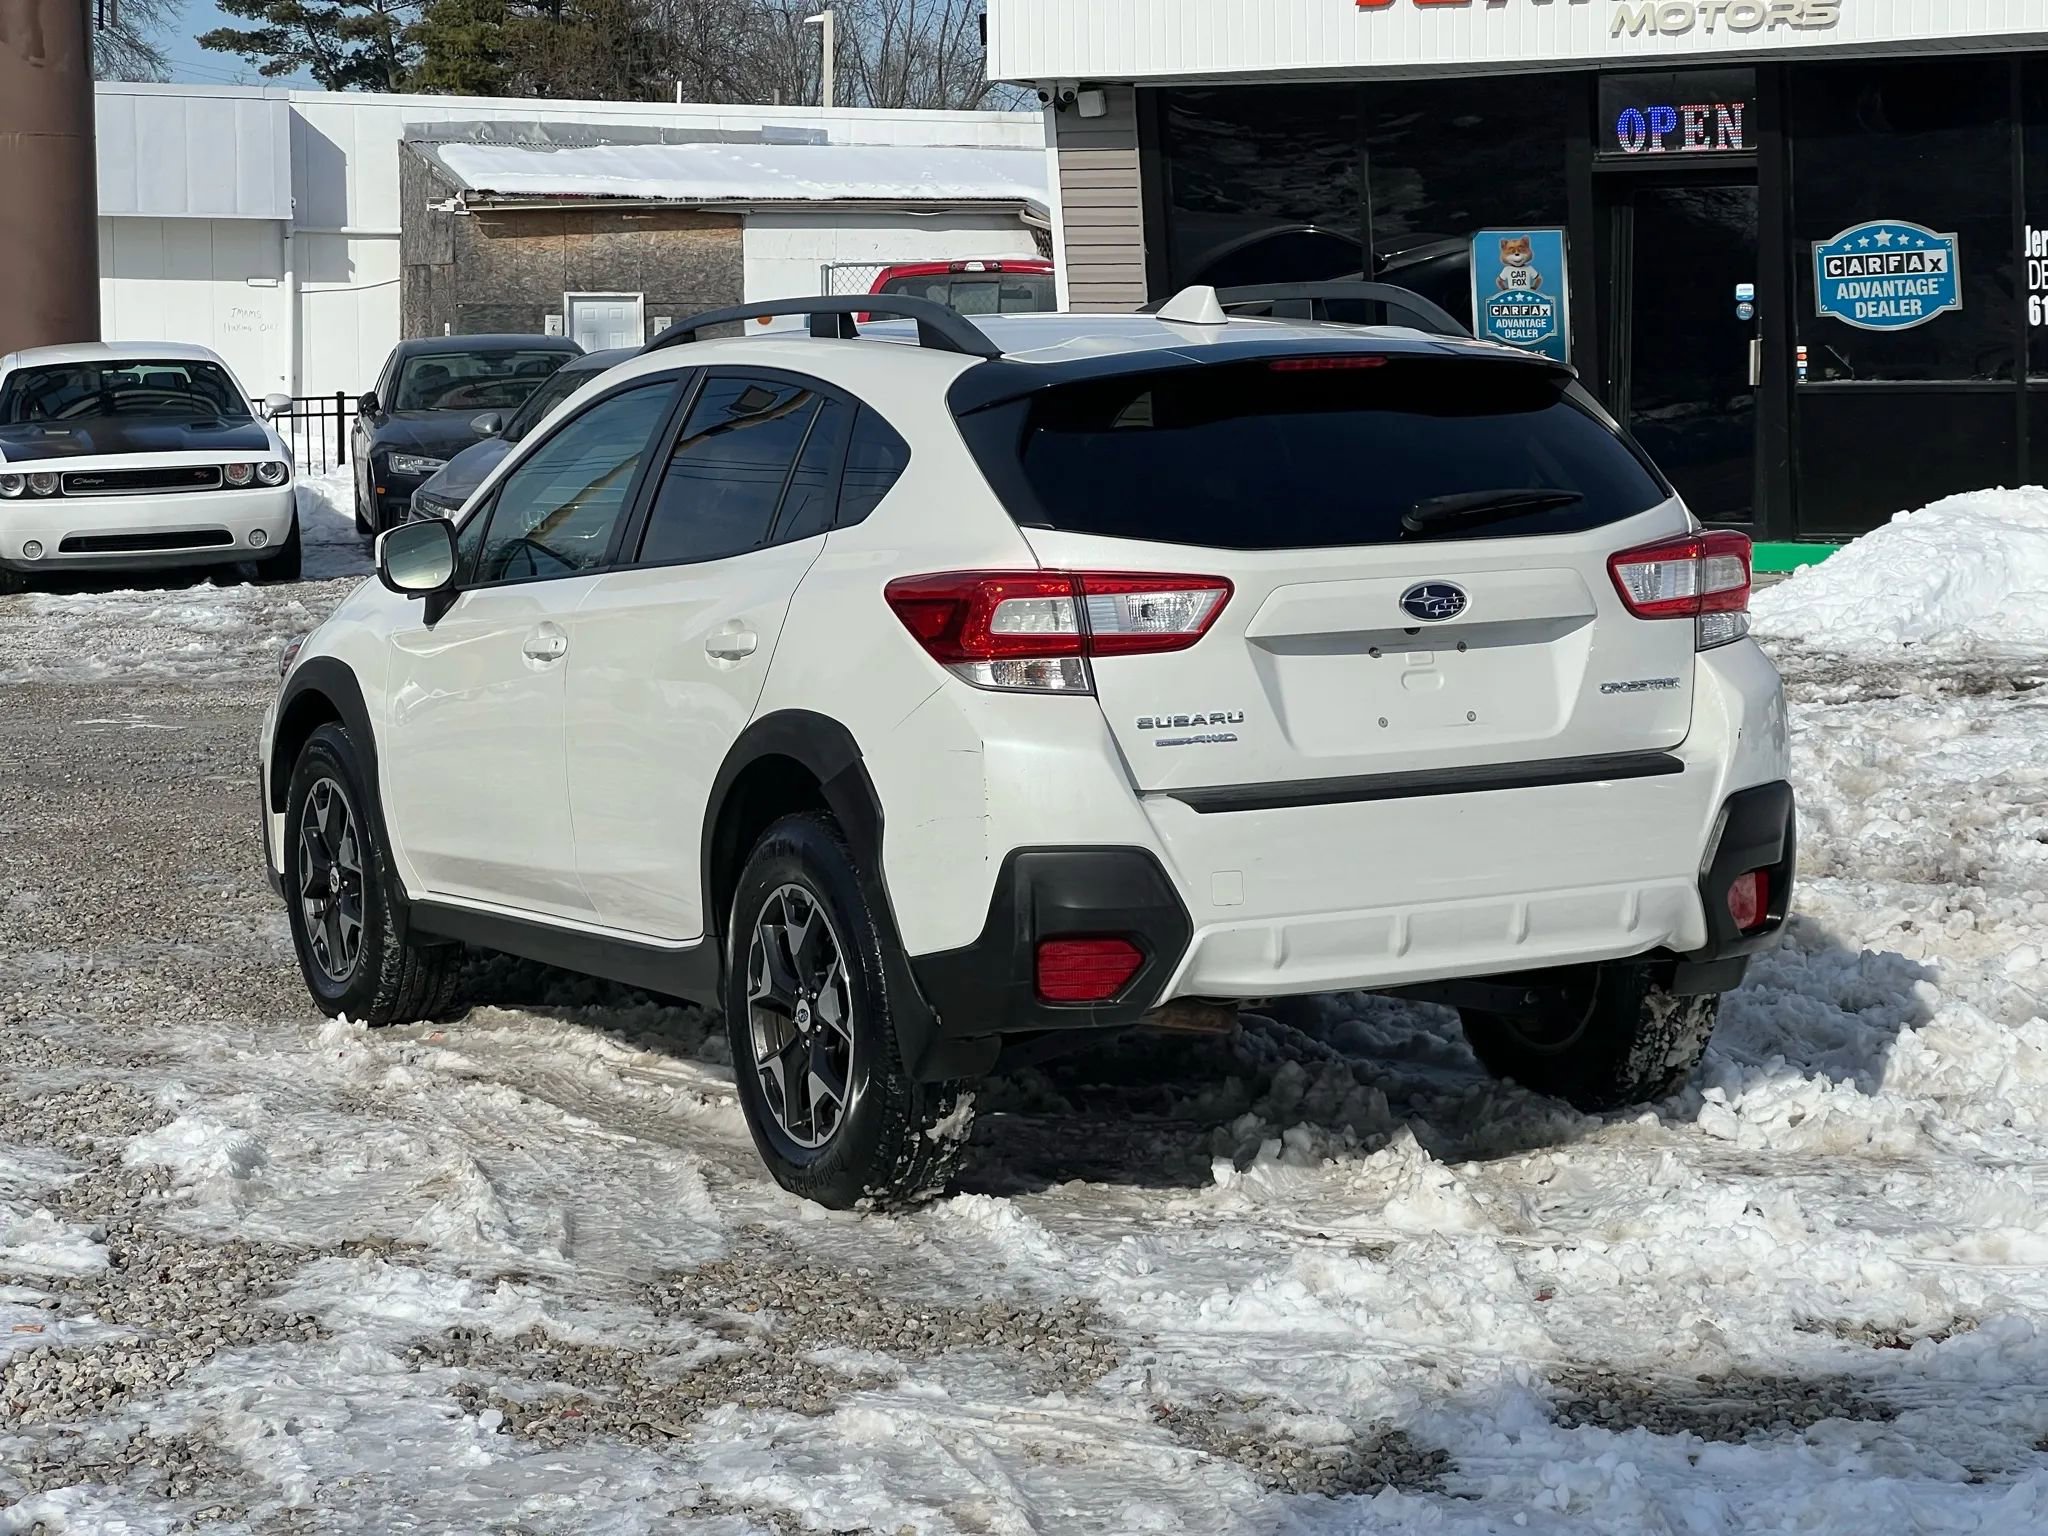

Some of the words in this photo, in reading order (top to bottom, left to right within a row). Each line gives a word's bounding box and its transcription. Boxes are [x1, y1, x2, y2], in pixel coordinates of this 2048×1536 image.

[1609, 0, 1840, 38] MOTORS
[1617, 103, 1745, 152] OPEN
[1827, 252, 1946, 277] CARFAX
[1510, 270, 1527, 279] CAR
[1512, 278, 1527, 287] FOX
[1491, 305, 1550, 317] CARFAX
[1855, 300, 1922, 318] DEALER
[1496, 318, 1547, 328] ADVANTAGE
[1505, 328, 1539, 338] DEALER
[1137, 711, 1244, 729] SUBARU
